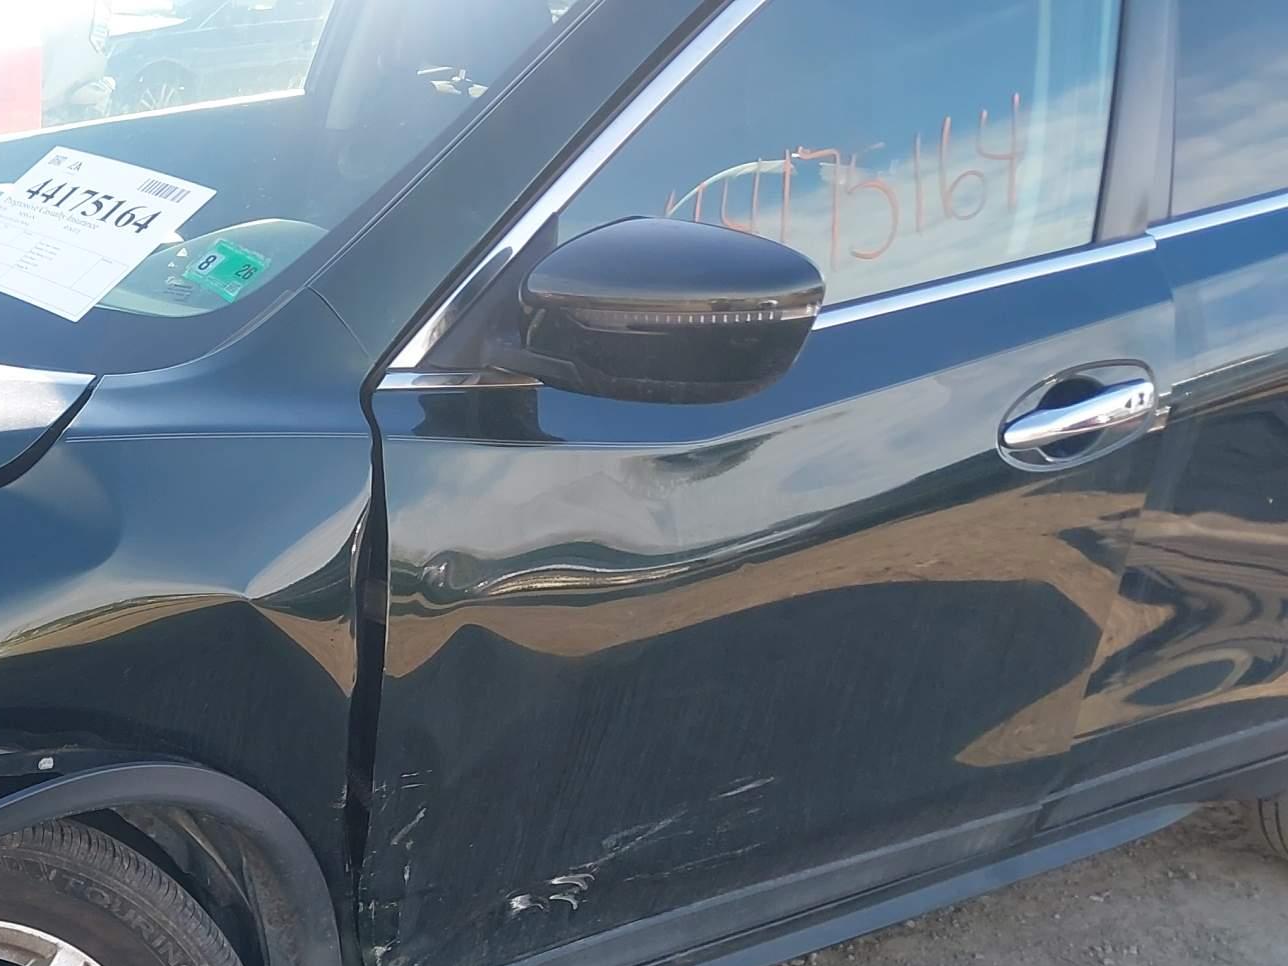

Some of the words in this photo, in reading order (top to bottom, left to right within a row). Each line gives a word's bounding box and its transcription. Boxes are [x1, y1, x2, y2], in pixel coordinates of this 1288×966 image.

[25, 178, 163, 234] 44175164
[198, 255, 217, 271] 8
[234, 263, 258, 280] 26
